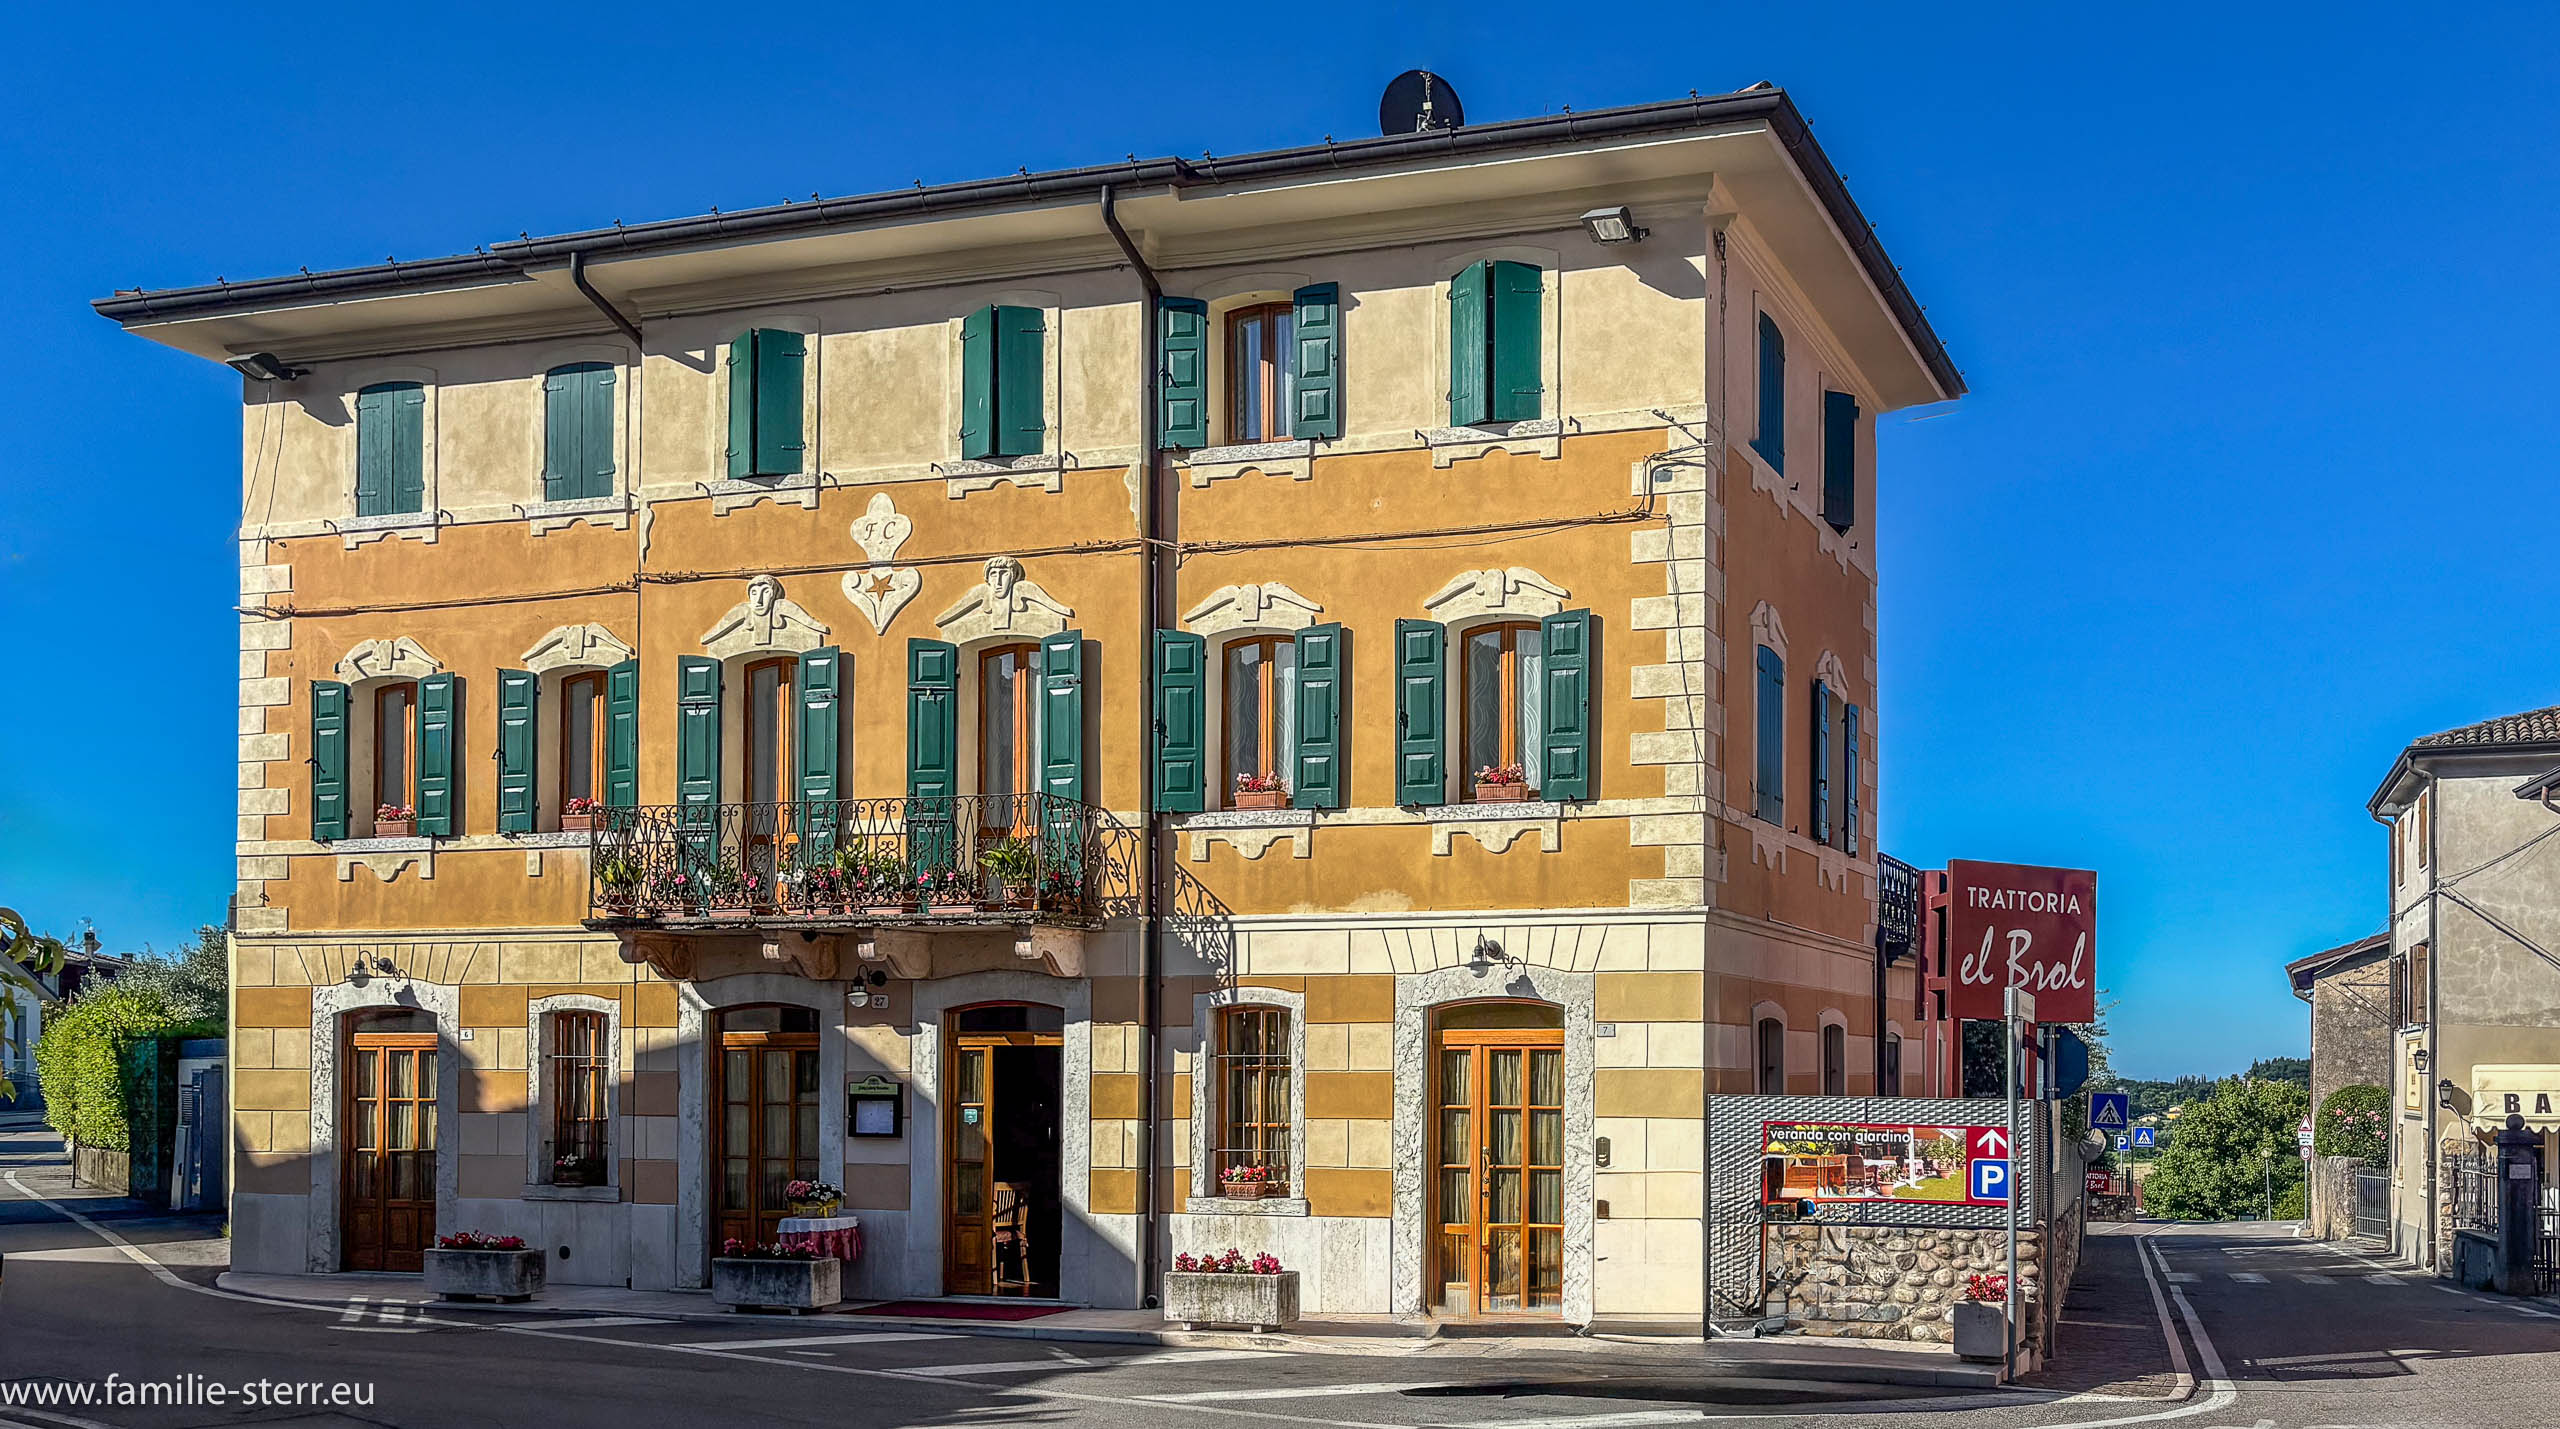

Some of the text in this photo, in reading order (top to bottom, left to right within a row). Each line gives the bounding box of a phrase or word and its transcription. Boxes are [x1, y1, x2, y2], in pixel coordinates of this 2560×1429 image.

[864, 520, 897, 541] F C
[1967, 886, 2081, 915] TRATTORIA
[1960, 925, 2086, 992] el Brol
[874, 996, 886, 1006] 27
[1770, 1128, 1911, 1144] veranda con giardino
[2117, 1136, 2127, 1149] P
[1981, 1165, 2005, 1195] P
